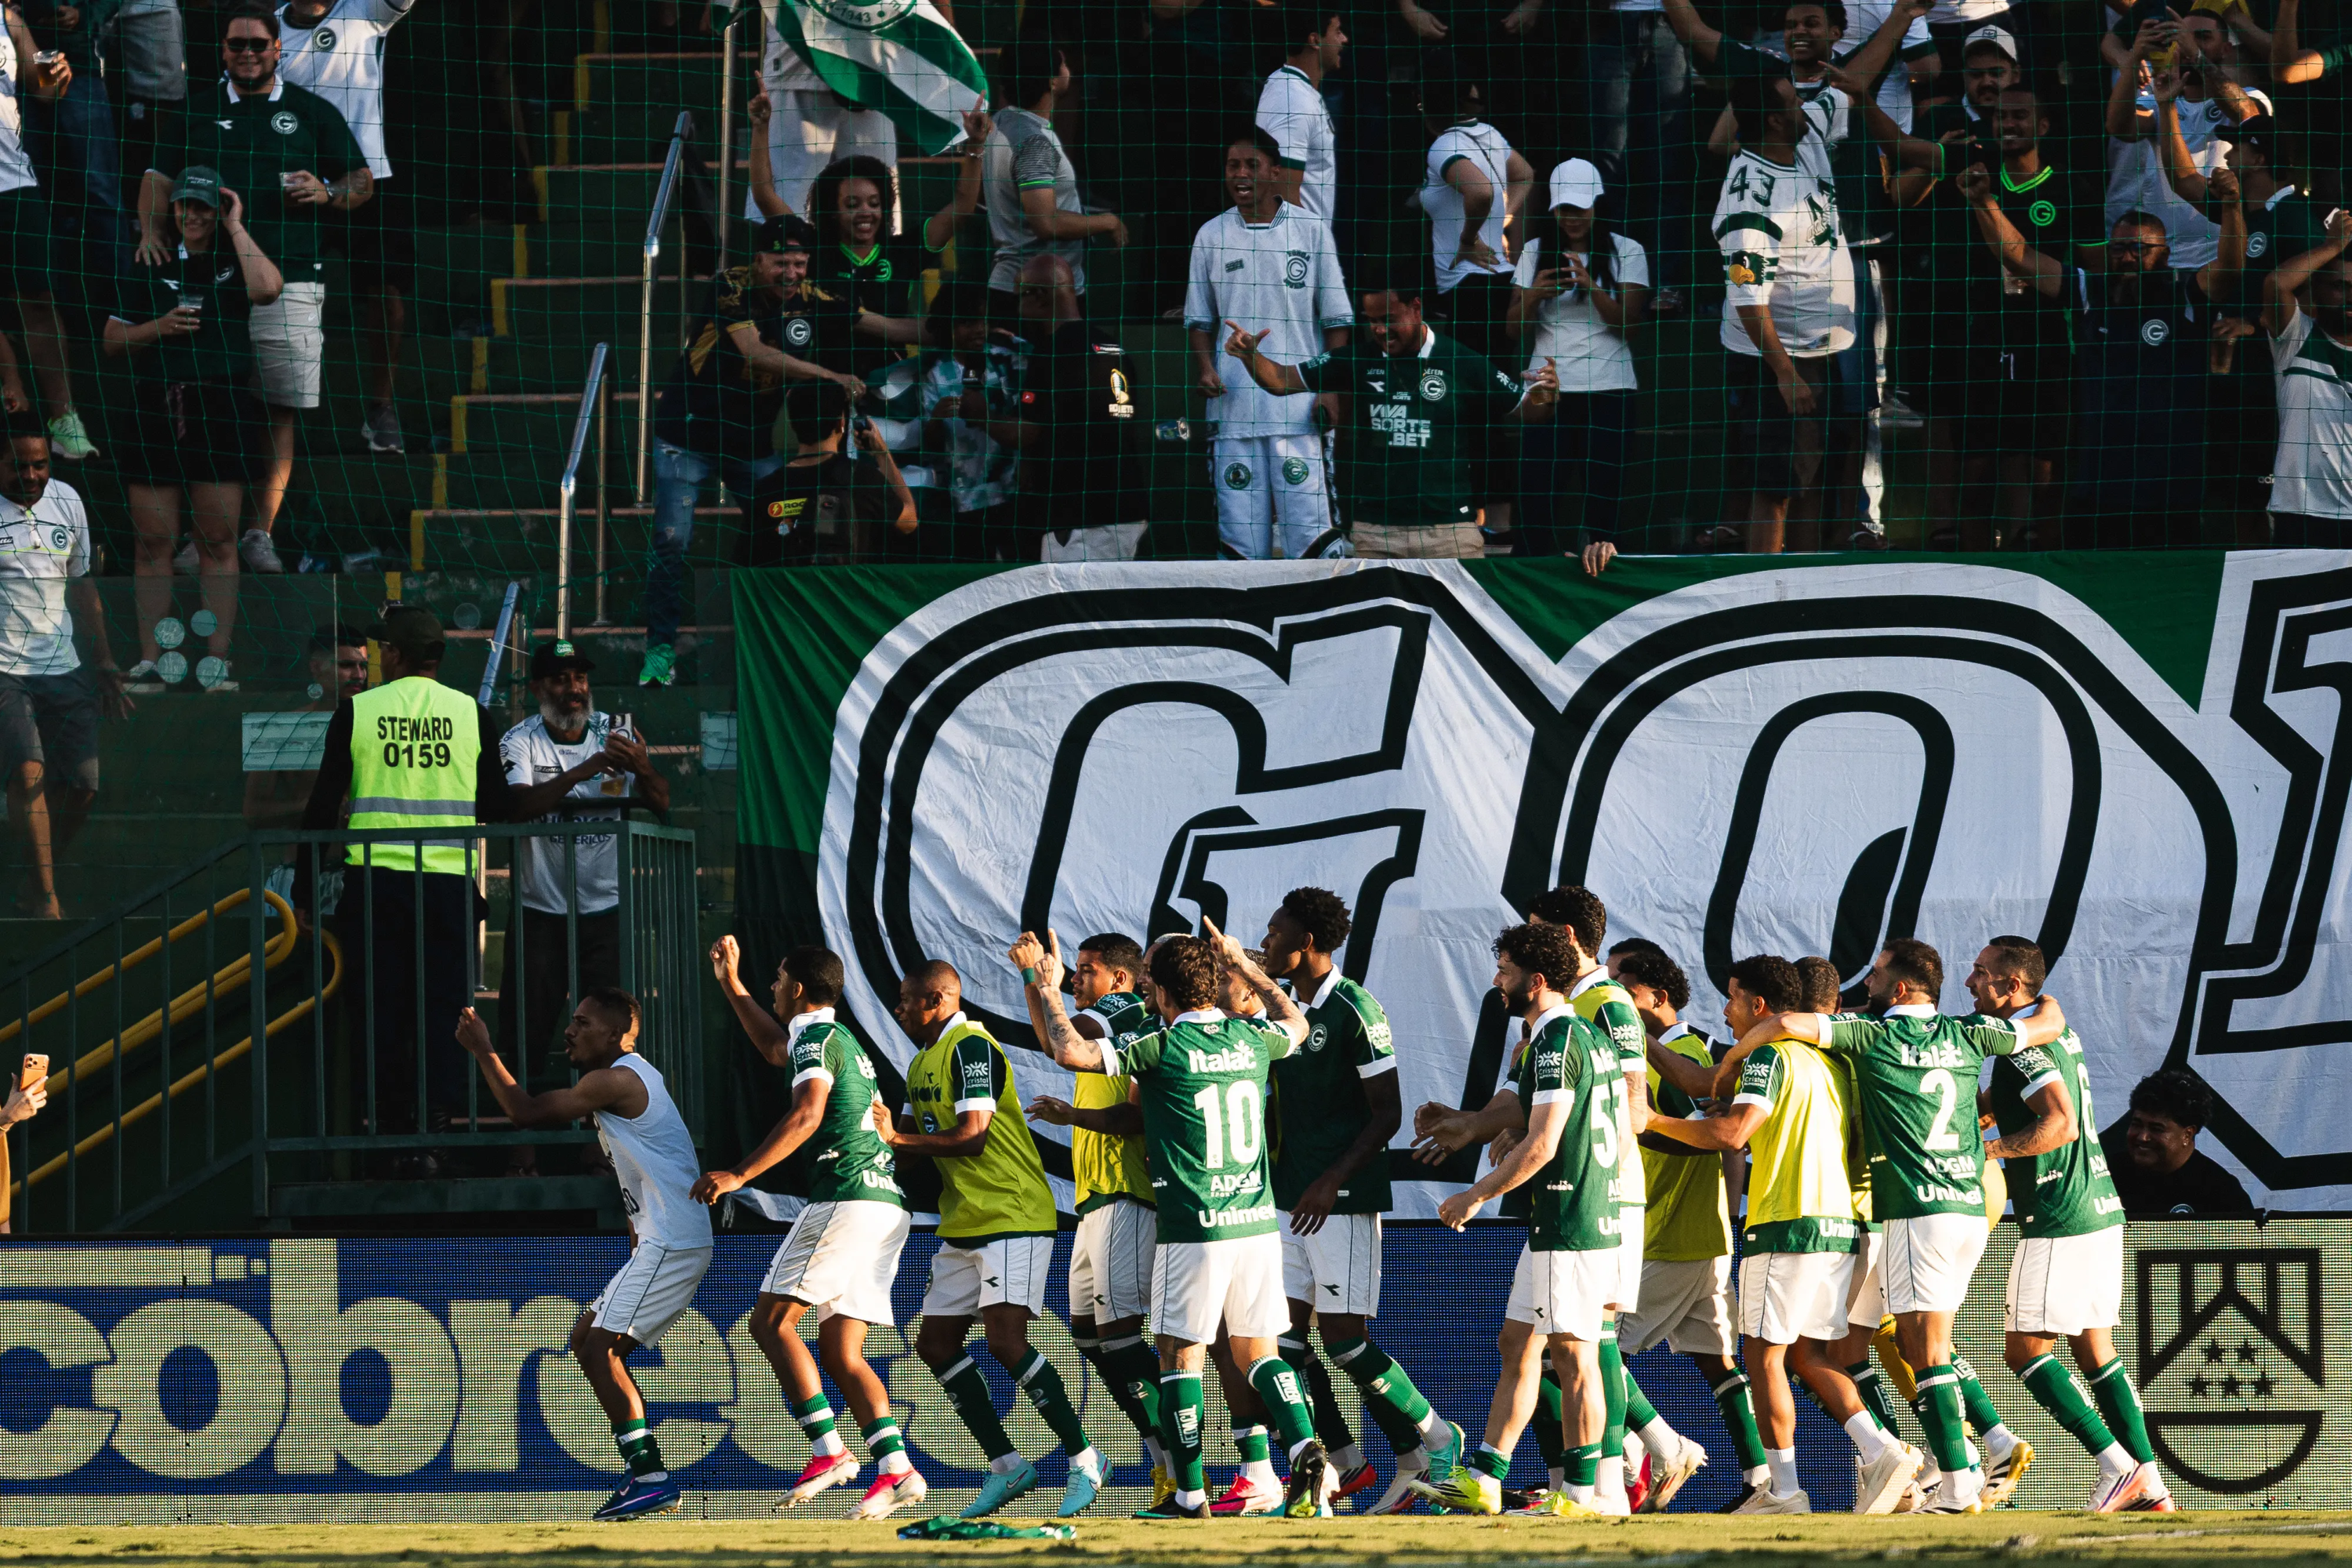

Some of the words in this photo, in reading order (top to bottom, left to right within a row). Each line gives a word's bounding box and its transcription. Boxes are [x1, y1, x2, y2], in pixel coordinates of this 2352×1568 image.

[1729, 165, 1775, 207] 43
[1370, 404, 1407, 419] VIVA
[1371, 418, 1432, 432] SORTE
[1388, 433, 1432, 448] .BET
[377, 715, 453, 742] STEWARD
[383, 742, 451, 768] 0159
[550, 833, 611, 845] GEERICOS
[1919, 1068, 1959, 1150] 2
[1194, 1080, 1261, 1169] 10
